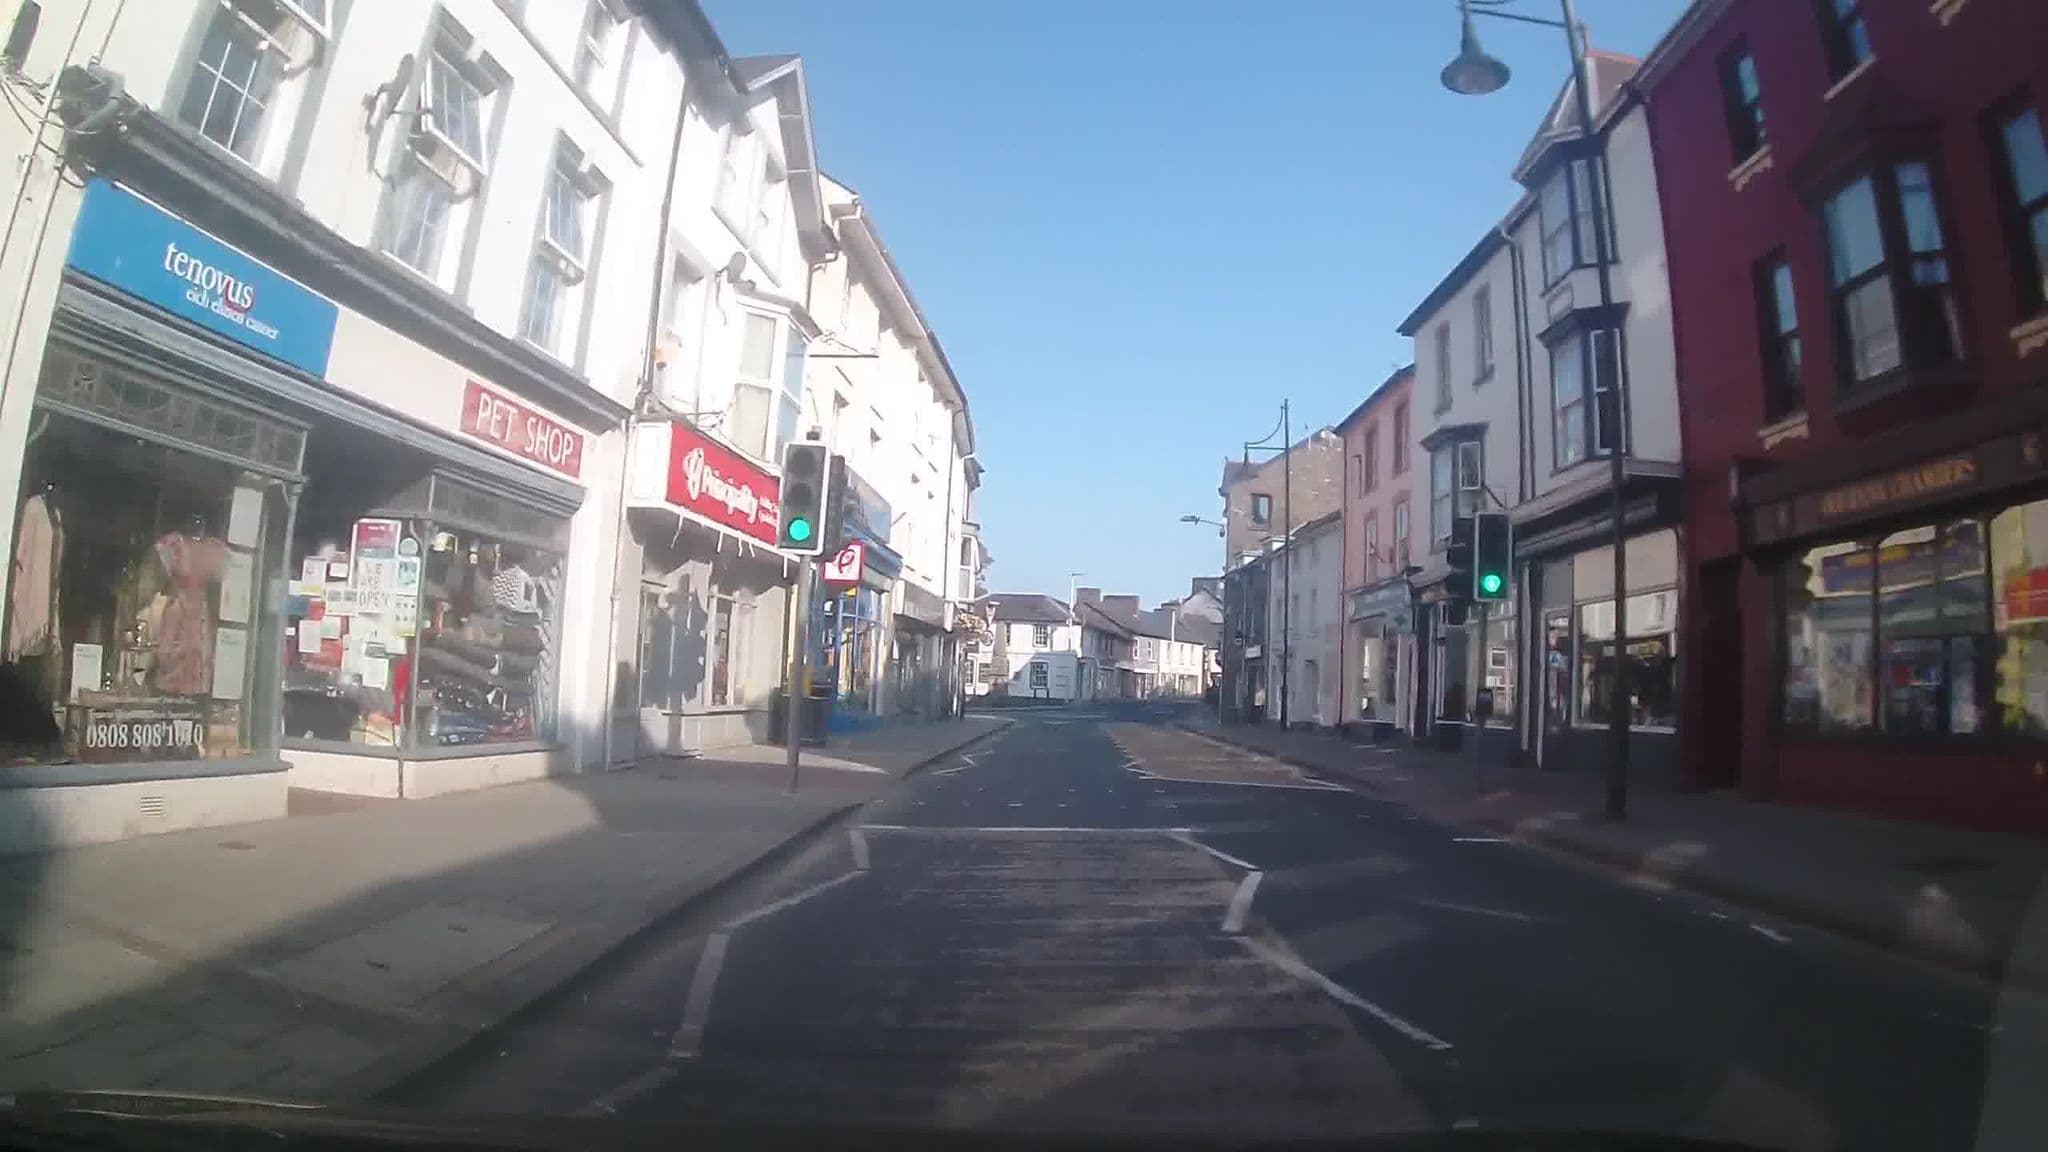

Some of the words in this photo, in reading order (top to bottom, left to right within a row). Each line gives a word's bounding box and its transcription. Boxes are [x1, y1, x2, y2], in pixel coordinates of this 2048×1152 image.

[164, 242, 254, 309] tenovus
[476, 391, 519, 442] PET
[524, 416, 574, 467] SHOP
[86, 723, 129, 748] 0808
[132, 723, 162, 747] 808
